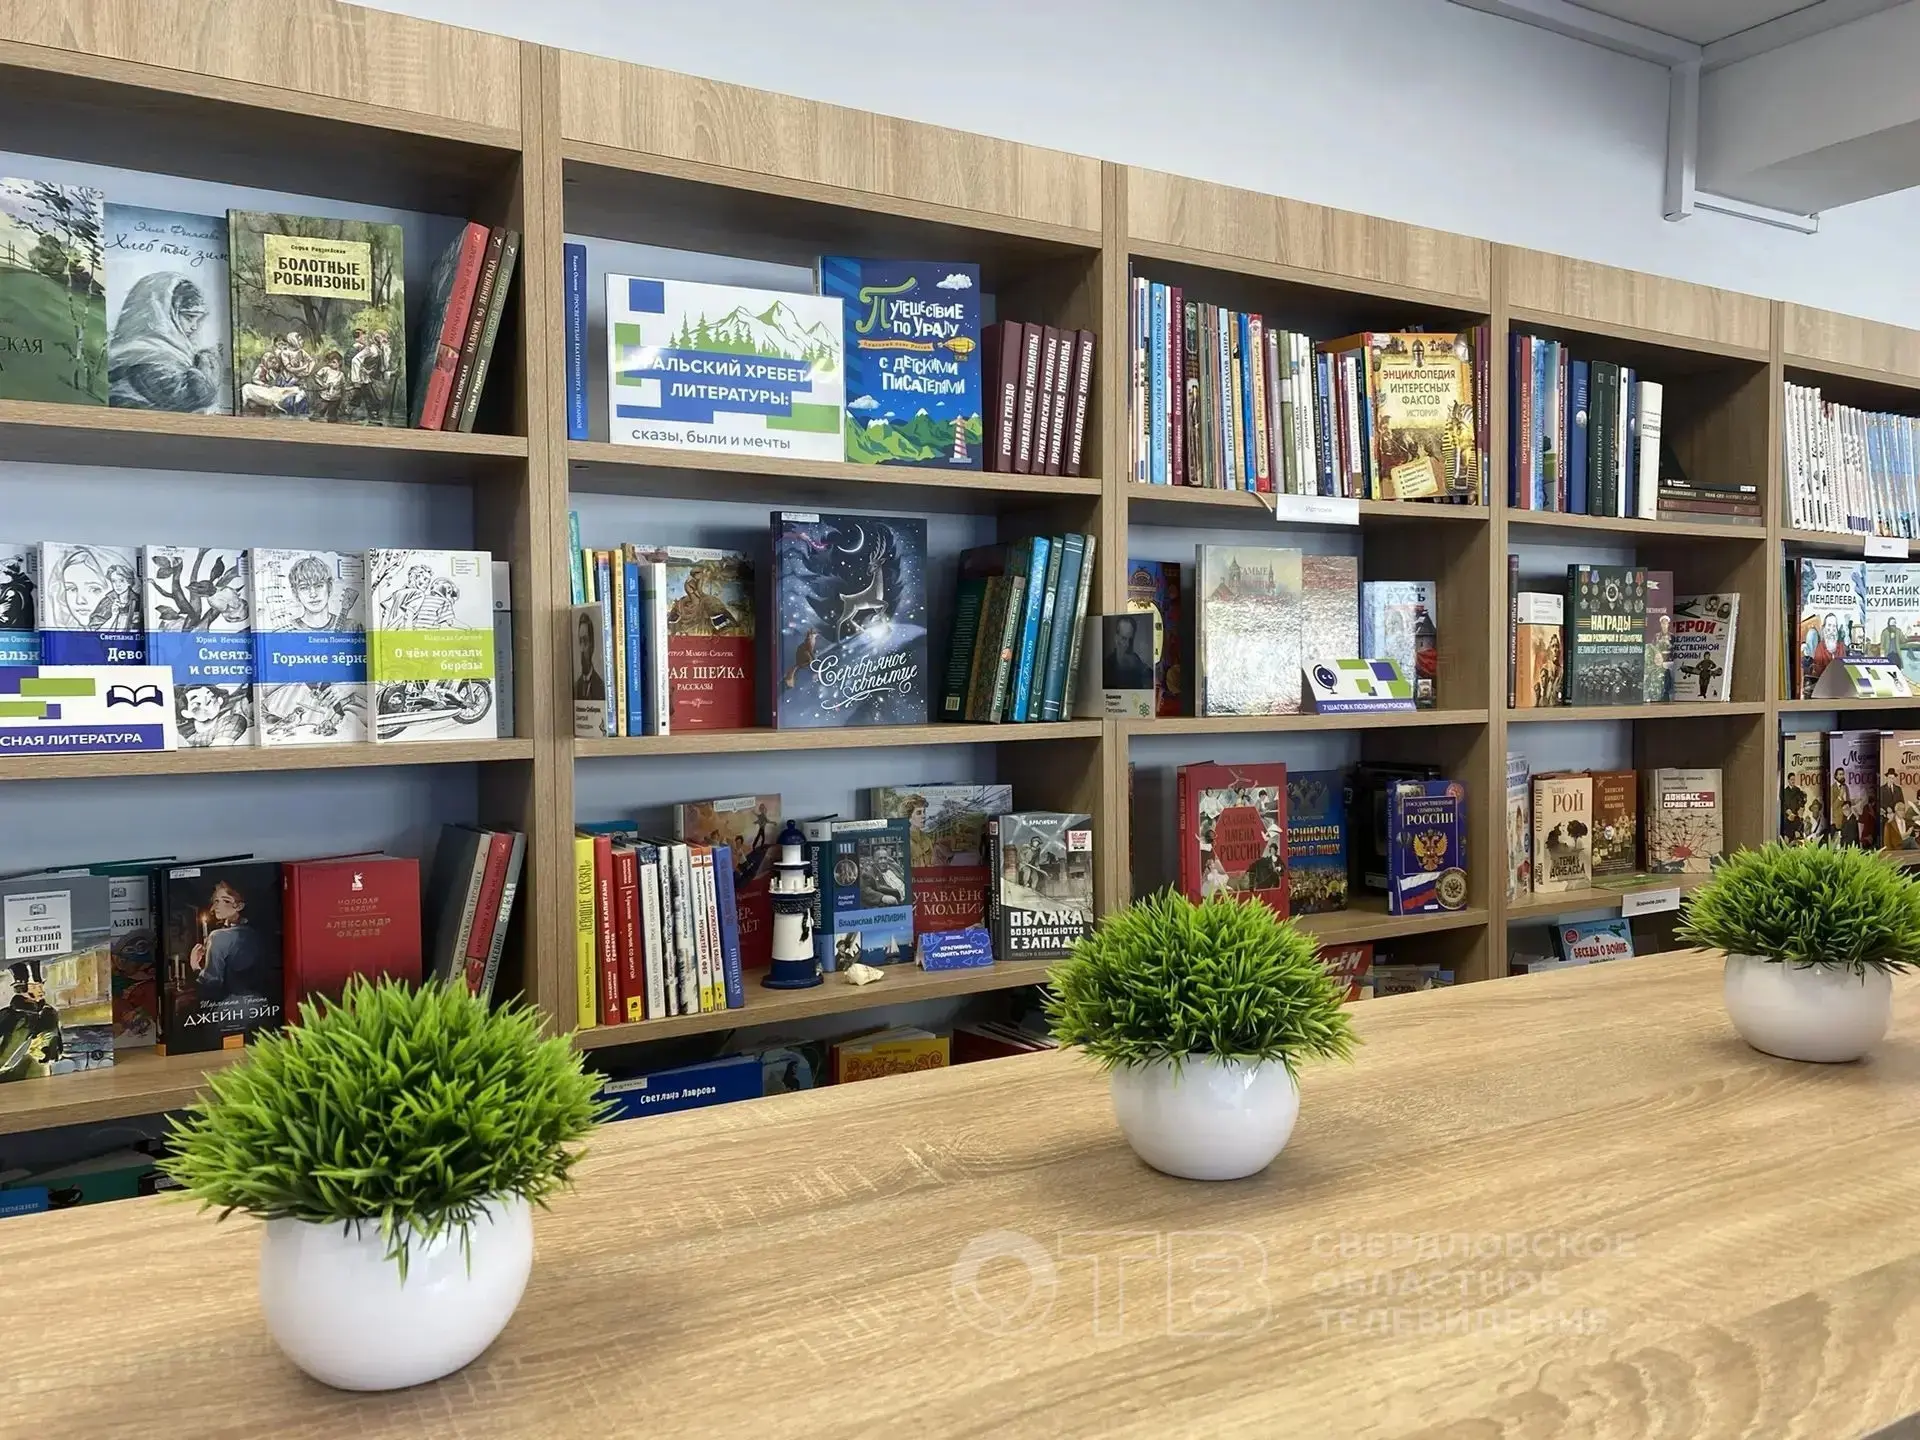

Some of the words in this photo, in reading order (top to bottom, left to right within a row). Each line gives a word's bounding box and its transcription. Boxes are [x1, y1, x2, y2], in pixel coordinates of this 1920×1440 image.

[105, 234, 159, 253] Хлеб
[161, 243, 191, 257] той
[191, 249, 229, 268] зим
[278, 256, 361, 277] БОЛОТНЫЕ
[273, 270, 366, 292] РОБИНЗОНЫ
[465, 319, 481, 352] МАЛЬЧИК
[478, 259, 498, 304] ЛЕНИНГРАДА
[0, 336, 43, 354] СКАЯ
[643, 358, 741, 378] АЛЬСКИЙ
[745, 363, 806, 383] ХРЕБЕТ
[1382, 368, 1456, 381] ЭНЦИКЛОПЕДИЯ
[670, 383, 789, 405] ЛИТЕРАТУРЫ:
[1390, 383, 1450, 394] ИНТЕРЕСНЫХ
[1005, 383, 1016, 415] ГНЕЗДО
[1020, 389, 1034, 461] ПРИВАЛОВСКИЕ
[1028, 334, 1040, 388] МИЛЛИОНЫ
[1038, 392, 1051, 464] ПРИВАЛОВСКИЕ
[1045, 337, 1057, 391] МИЛЛИОНЫ
[1051, 394, 1065, 465] ПРИВАЛОВСКИЕ
[1058, 340, 1071, 393] МИЛЛИОНЫ
[1072, 394, 1086, 465] ПРИВАЛОВСКИЕ
[1080, 340, 1093, 393] МИЛЛИОНЫ
[1401, 394, 1441, 406] ФАКТОВ
[1405, 408, 1439, 418] ИСТОРИЯ
[1224, 405, 1232, 450] ПОРТРЕТЫ
[632, 429, 684, 444] сказы,
[686, 429, 727, 445] были
[730, 435, 740, 446] и
[743, 436, 791, 449] мечты
[1002, 416, 1014, 457] ГОРНОЕ
[1826, 570, 1842, 580] МИР
[1885, 574, 1909, 584] МИР
[1817, 581, 1851, 593] УЧЁНОГО
[1866, 586, 1920, 596] МЕХАНИК
[1810, 594, 1857, 606] МЕНДЕЛЕЕВА
[1866, 598, 1919, 607] КУЛИБИН
[1591, 614, 1631, 632] НАГРАДЫ
[107, 647, 144, 662] Дево
[199, 648, 253, 660] Смеять
[406, 649, 429, 659] чём
[431, 649, 483, 659] молчали
[1577, 644, 1596, 654] ВЕЛИКОЙ
[272, 652, 328, 667] Горькие
[189, 665, 199, 675] и
[203, 665, 253, 675] свисте
[692, 665, 745, 679] ШЕЙКА
[810, 651, 908, 691] Серебряное
[677, 683, 713, 691] РАССКАЗЫ
[1328, 704, 1347, 712] ШАГОВ
[1353, 703, 1387, 711] ПОЗНАНИЮ
[1388, 702, 1413, 710] РОССИИ
[0, 735, 44, 747] СНАЯ
[47, 733, 143, 746] ЛИТЕРАТУРА
[1552, 789, 1584, 813] РОЙ
[1664, 792, 1701, 802] ДОНБАСС
[1663, 801, 1688, 809] СЕРДЦЕ
[1690, 800, 1714, 809] РОССИИ
[1406, 812, 1454, 826] РОССИИ
[1224, 828, 1255, 842] ИМЕНА
[1287, 824, 1340, 844] ССИЙСКАЯ
[1220, 843, 1262, 862] РОССИИ
[337, 896, 379, 905] МОЛОДАЯ
[913, 888, 985, 904] УРАВЛЁНО
[112, 917, 144, 929] АЗКИ
[326, 917, 391, 929] АЛЕКСАНДР
[838, 916, 873, 928] Владислав
[874, 912, 907, 924] КРАПИВИН
[1010, 910, 1084, 927] ОБЛАКА
[15, 932, 62, 945] ЕВГЕНИЙ
[336, 928, 381, 939] ФАДЕЕВ
[708, 905, 718, 948] ОРУЖЕНОСЕЦ
[713, 949, 721, 971] КАШКА
[18, 943, 60, 954] ОНЕГИН
[1010, 937, 1018, 950] С
[1021, 936, 1072, 949] ЗАПАД
[1573, 945, 1600, 958] БЕСЕДЫ
[1606, 941, 1628, 955] ВОЙНЕ
[486, 933, 504, 979] КАЗАКЕВИЧ
[959, 948, 985, 957] ПАРУСА!
[184, 1009, 244, 1028] ДЖЕЙН
[249, 1004, 280, 1021] ЭЙР
[640, 1092, 680, 1104] Светлана
[681, 1085, 716, 1099] Лаврова
